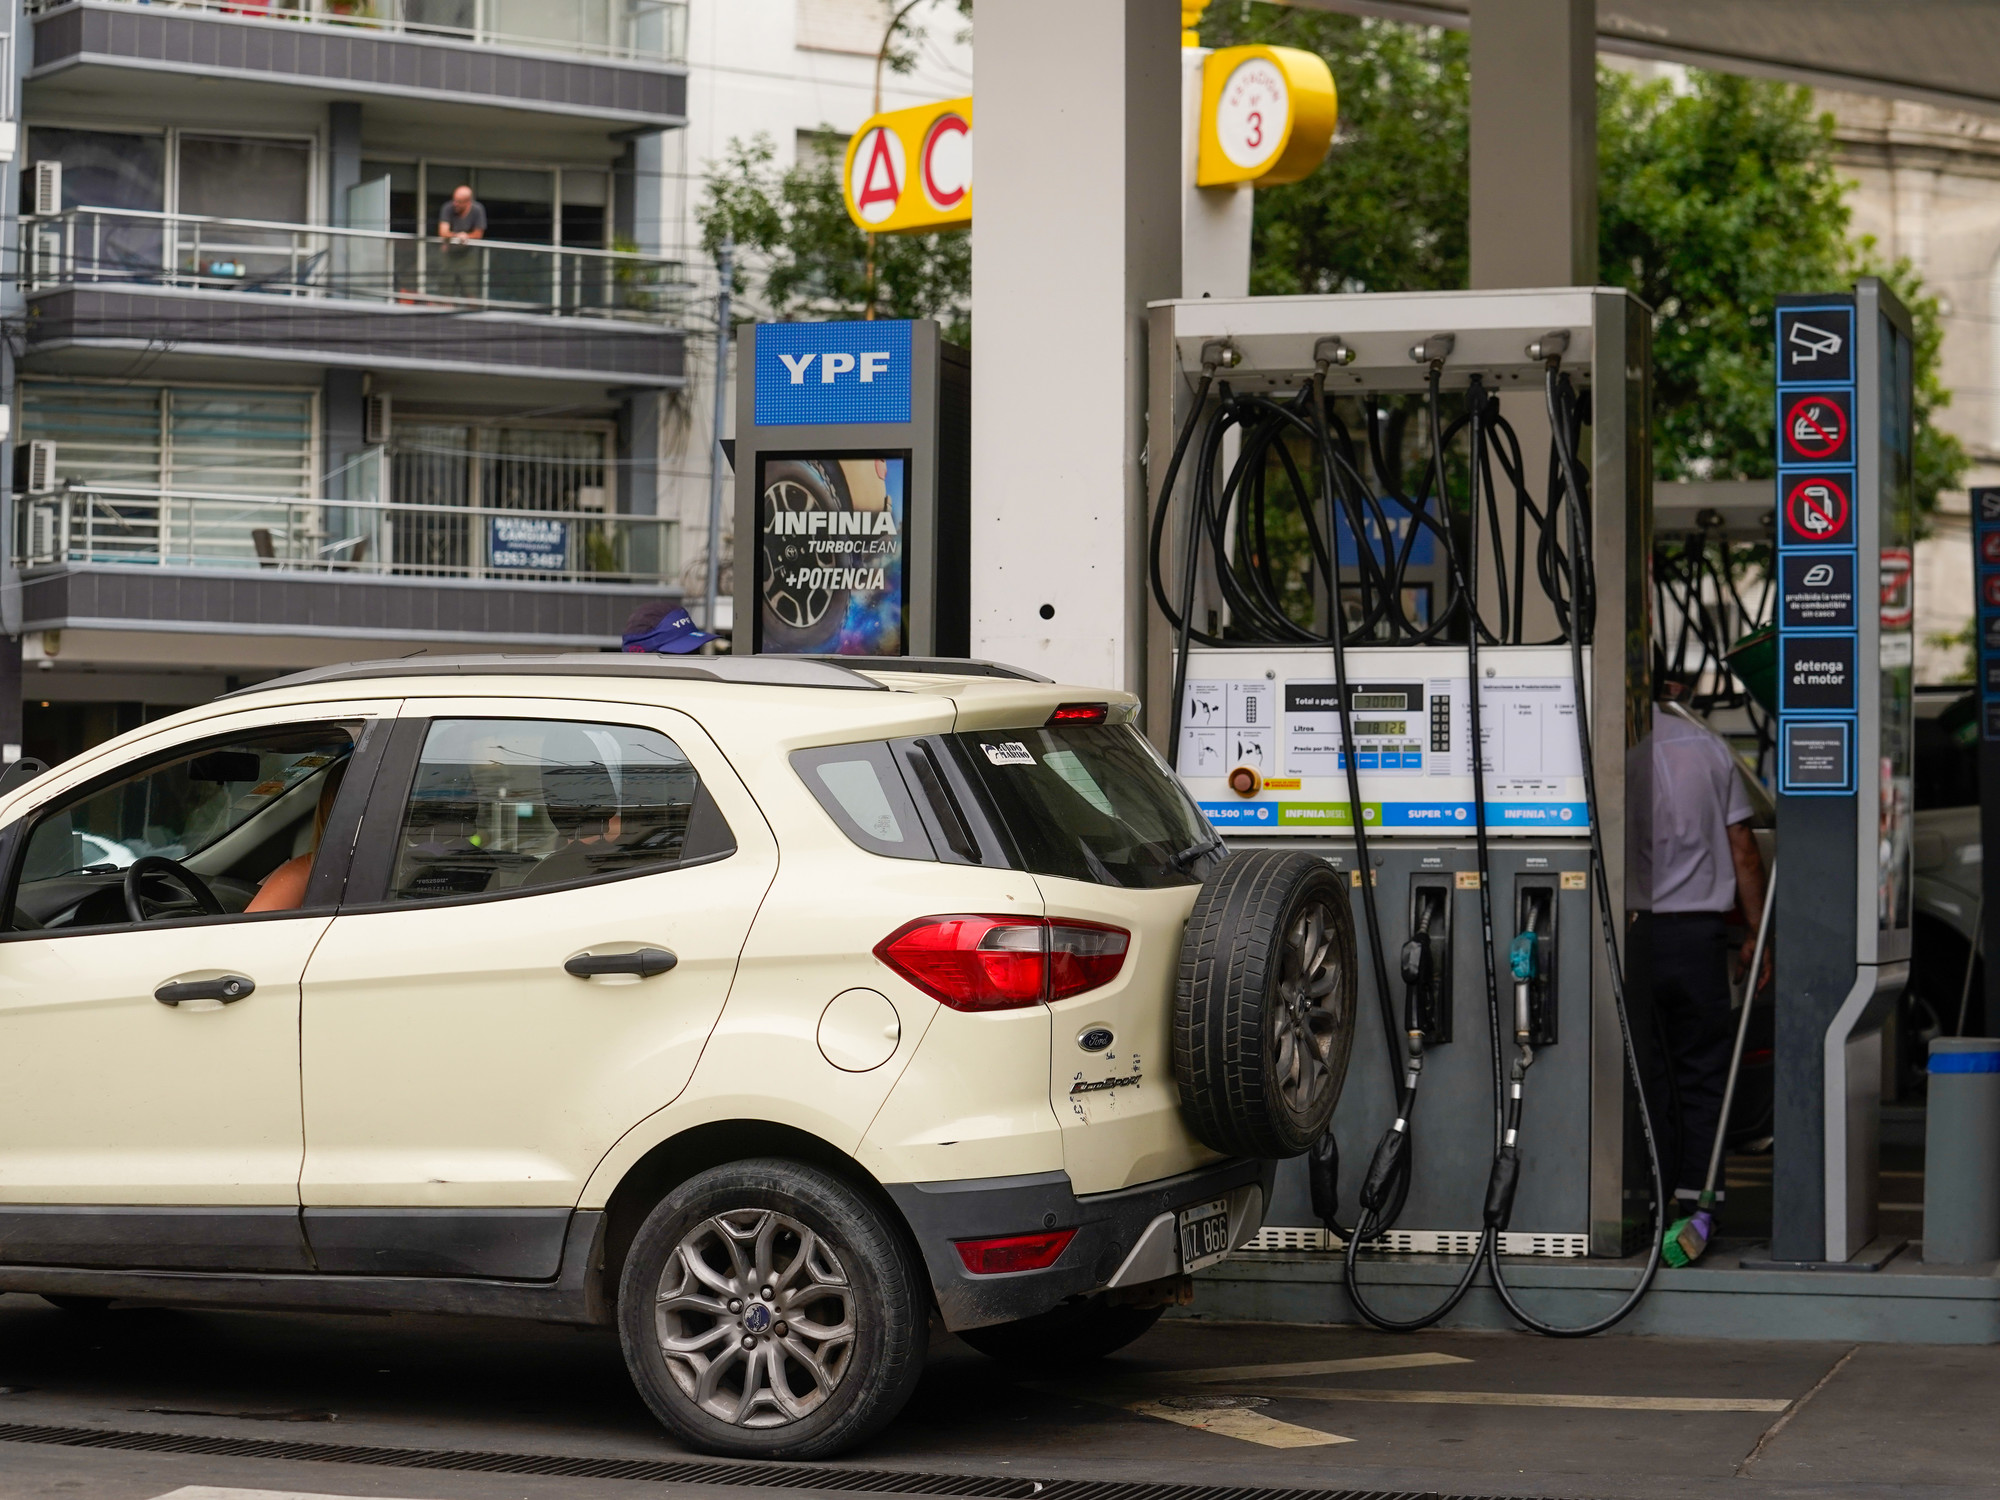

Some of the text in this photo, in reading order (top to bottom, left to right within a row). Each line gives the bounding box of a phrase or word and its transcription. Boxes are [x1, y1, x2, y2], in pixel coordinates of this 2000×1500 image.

[1246, 111, 1263, 148] 3
[778, 352, 890, 384] YPF
[774, 511, 897, 535] INFINIA
[808, 541, 897, 553] TURBOCLEAN
[786, 567, 885, 590] +POTENCIA
[1785, 593, 1821, 602] prohibida
[1831, 593, 1851, 601] venta
[1801, 602, 1847, 610] combustible
[1801, 610, 1837, 618] sin casco
[1794, 659, 1844, 674] detenga
[1793, 672, 1846, 685] el motor
[1320, 698, 1339, 707] paga
[1408, 810, 1441, 818] SUPER
[1504, 809, 1546, 818] INFINIA
[1088, 1032, 1108, 1047] Ford
[1203, 1216, 1227, 1253] 866
